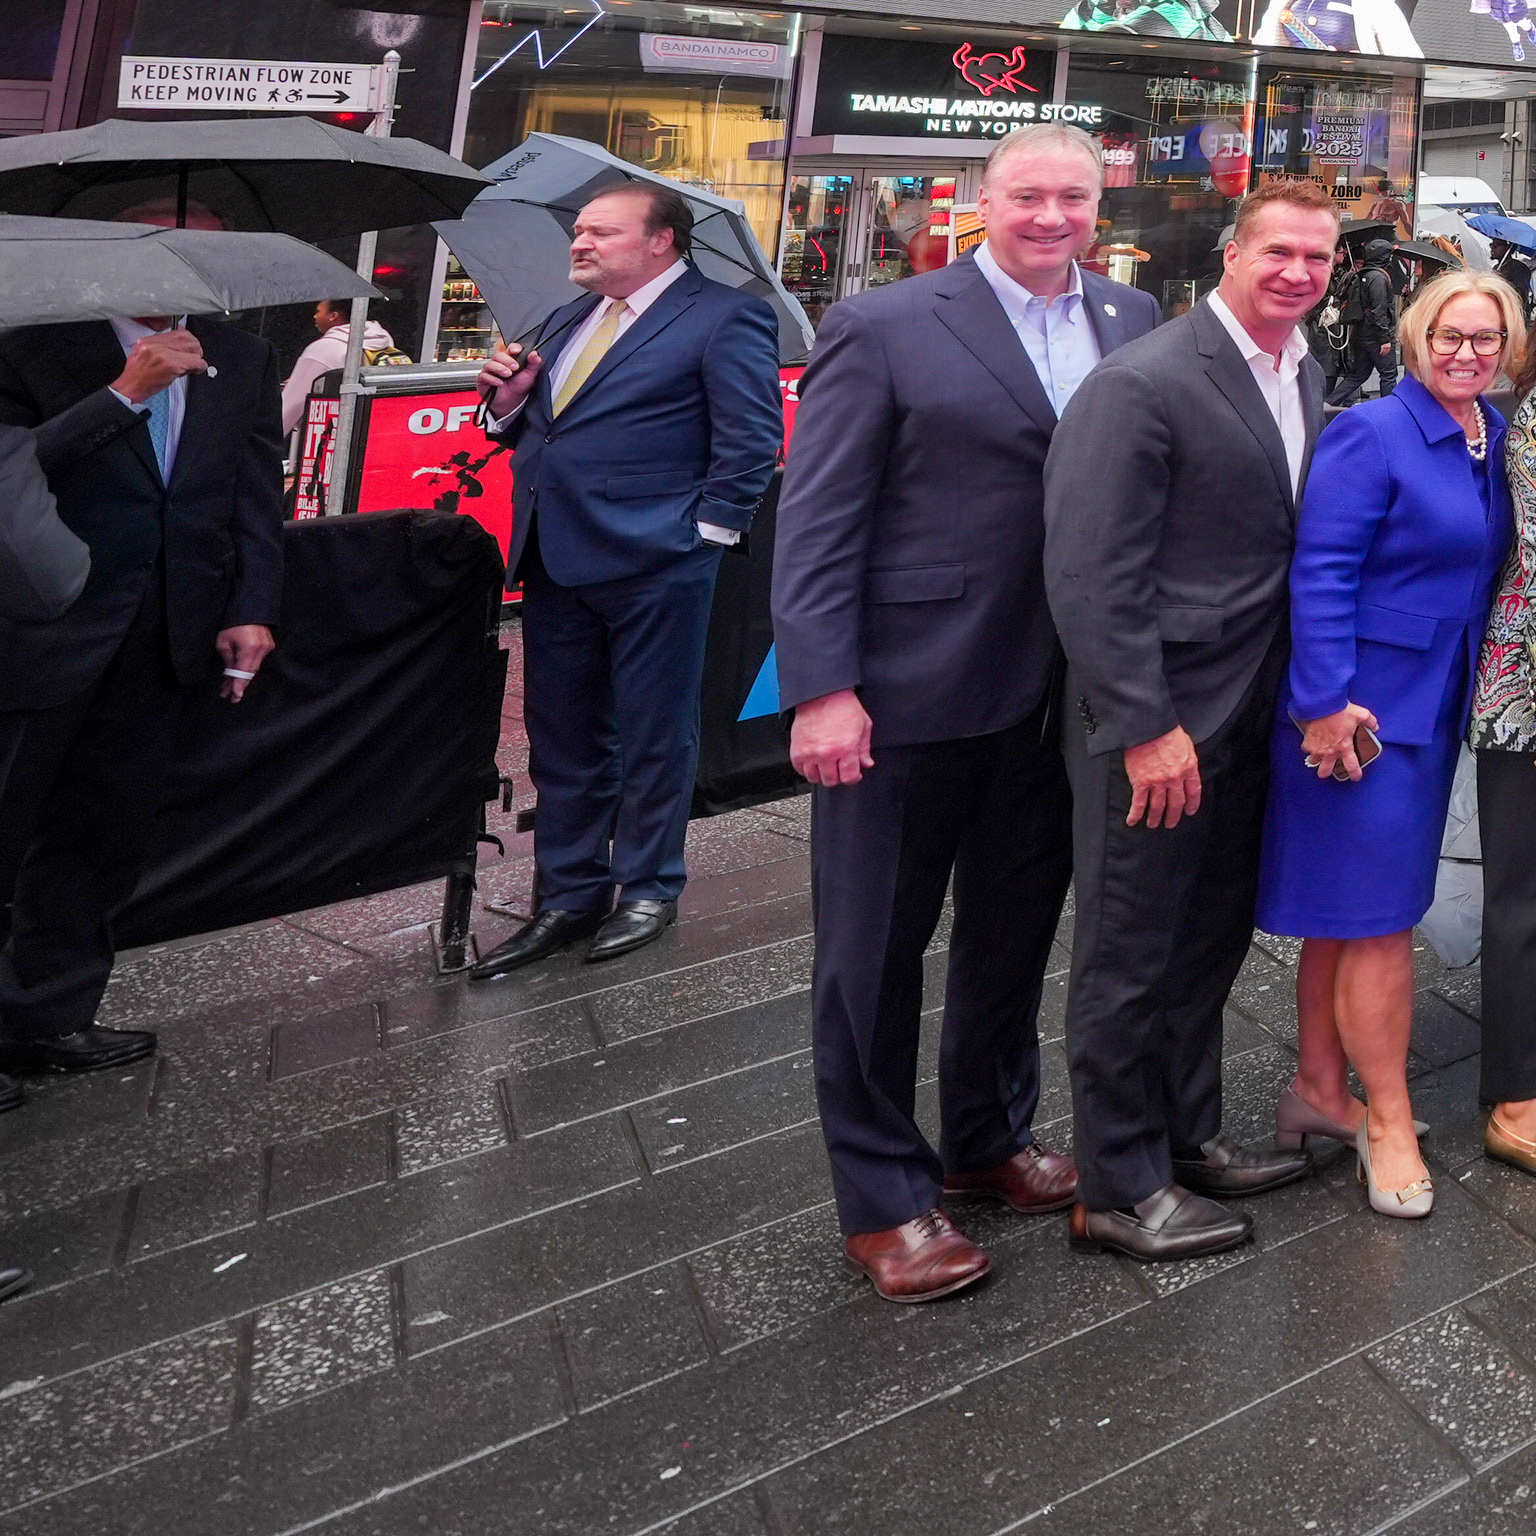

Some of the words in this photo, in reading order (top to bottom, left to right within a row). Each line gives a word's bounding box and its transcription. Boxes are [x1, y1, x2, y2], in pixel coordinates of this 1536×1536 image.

[133, 65, 250, 82] PEDESTRIAN
[257, 68, 304, 83] FLOW
[310, 70, 352, 84] ZONE
[131, 85, 179, 100] KEEP
[187, 87, 257, 102] MOVING
[949, 99, 1035, 119] NATIONS
[1040, 103, 1102, 124] STORE
[927, 118, 972, 132] NEW
[1317, 116, 1365, 125] PREMIUM
[1315, 143, 1363, 156] 2025
[1331, 186, 1362, 198] ZORO
[309, 400, 328, 423] BEAT
[305, 423, 324, 458] IT
[297, 497, 319, 510] BILLIE
